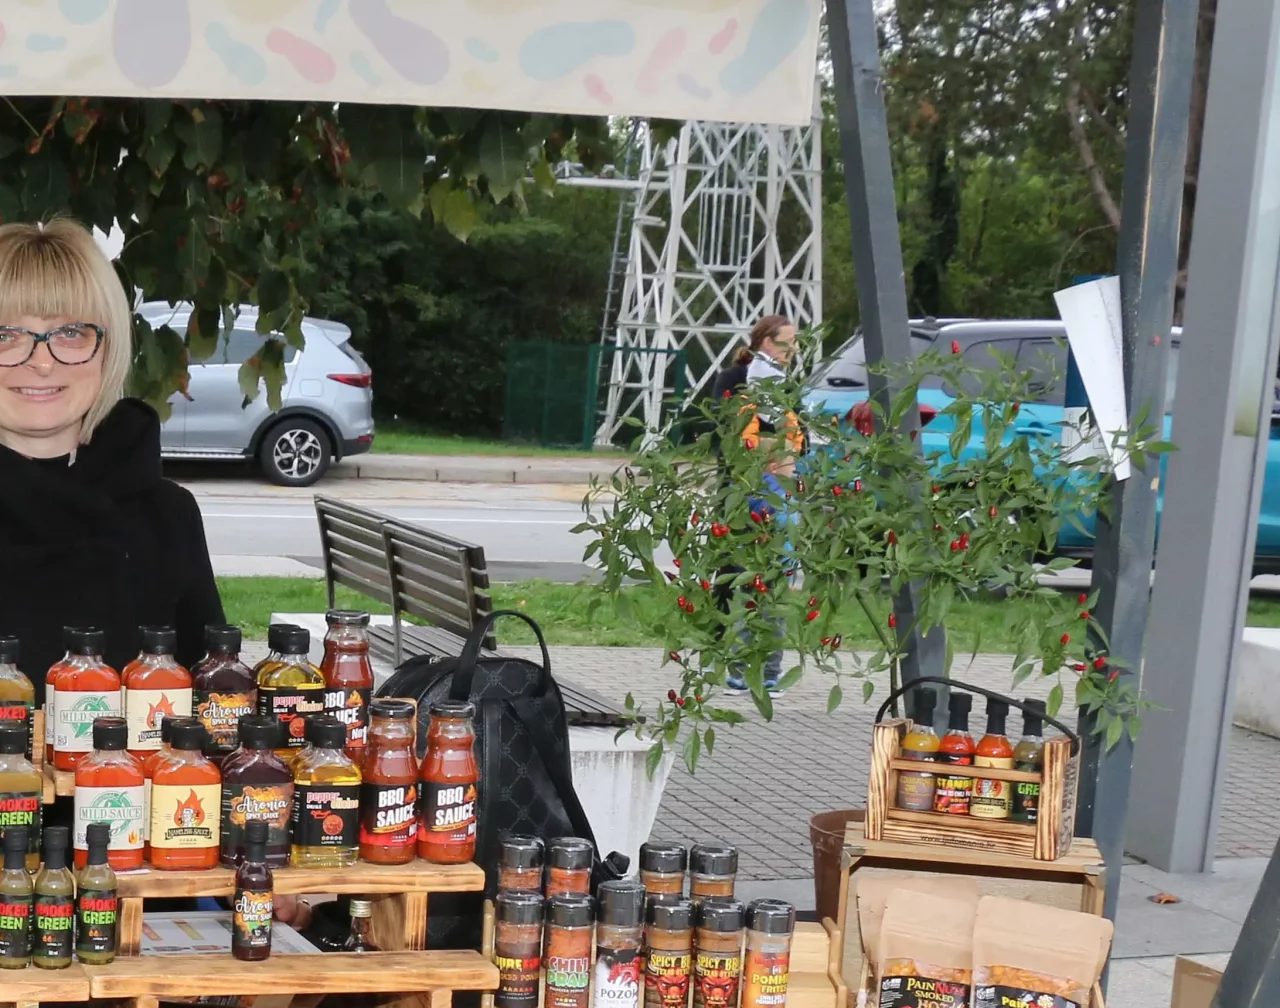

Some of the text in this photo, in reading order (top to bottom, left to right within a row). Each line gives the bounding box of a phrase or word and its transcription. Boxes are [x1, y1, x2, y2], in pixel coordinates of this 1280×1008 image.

[273, 696, 306, 708] pepper
[63, 711, 86, 722] MILD
[202, 702, 253, 718] Aronia
[307, 792, 341, 803] pepper
[378, 788, 405, 807] BBQ
[438, 786, 464, 806] BBQ
[237, 796, 288, 813] Aronia
[81, 808, 141, 819] MILD SAUCE
[377, 802, 415, 827] SAUCE
[436, 802, 474, 825] SAUCE
[38, 915, 72, 930] GREEN
[83, 910, 117, 925] GREEN
[548, 956, 589, 973] CHILI
[651, 954, 678, 968] SPICY
[697, 954, 721, 969] SPICY
[915, 990, 954, 1003] SMOKED
